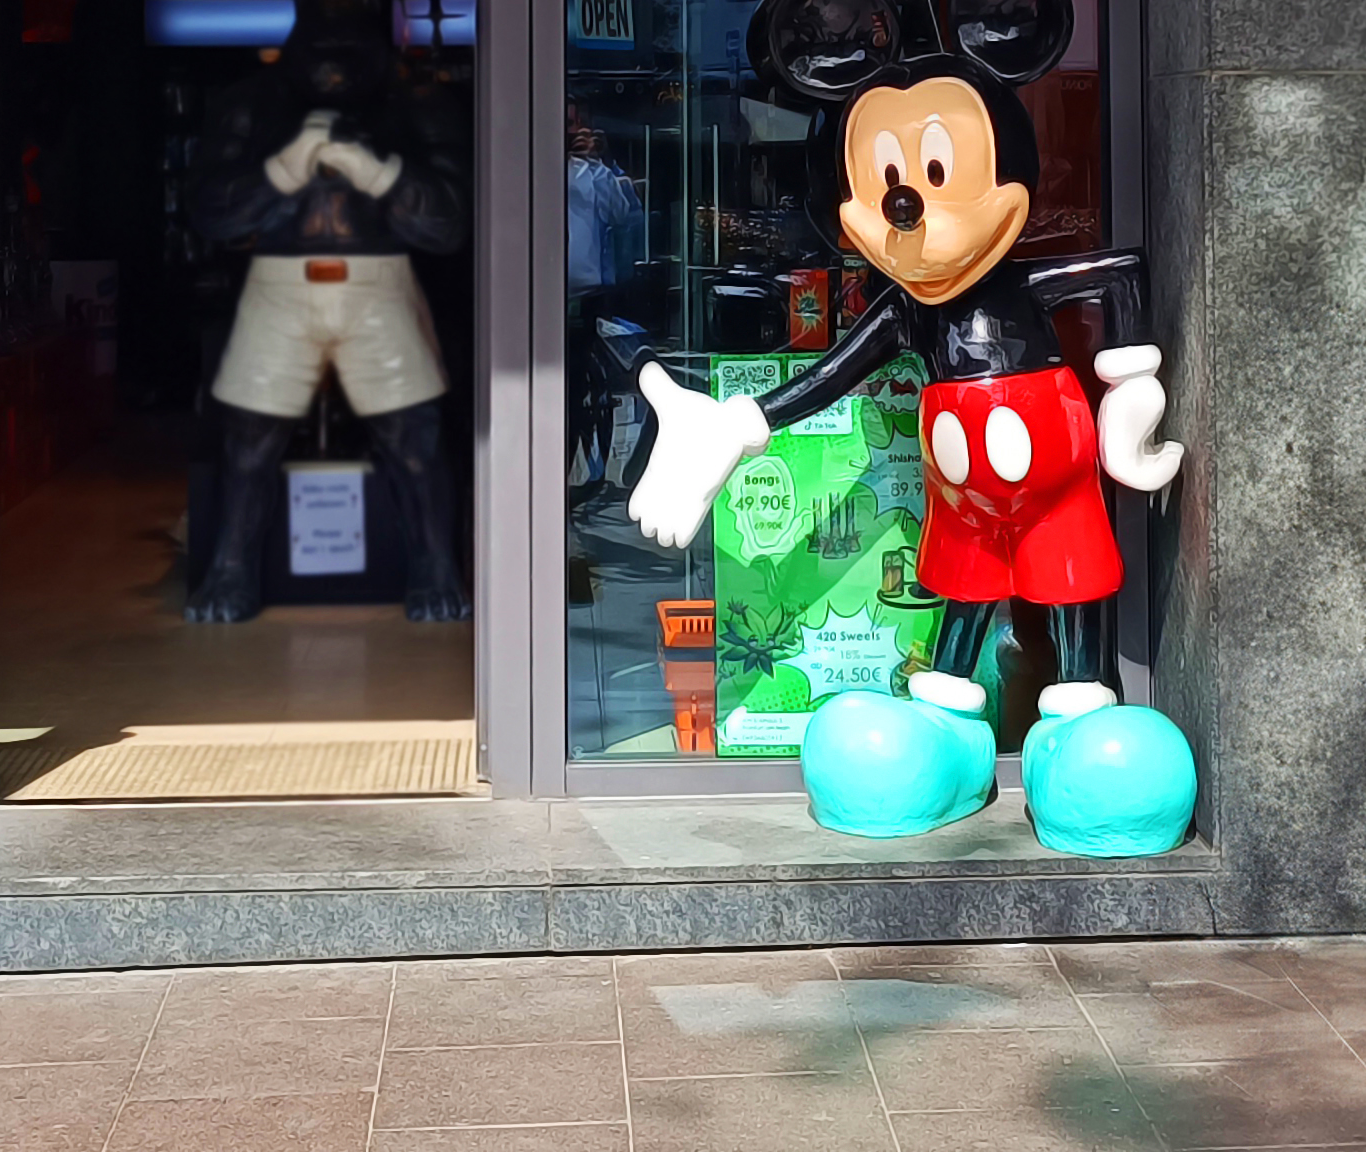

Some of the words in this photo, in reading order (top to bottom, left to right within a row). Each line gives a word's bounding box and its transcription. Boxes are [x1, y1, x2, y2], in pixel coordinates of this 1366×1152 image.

[745, 475, 780, 486] Bongs
[735, 495, 791, 511] 49.90€
[816, 631, 837, 641] 420
[840, 631, 881, 641] Sweets
[823, 666, 882, 683] 24.50€
